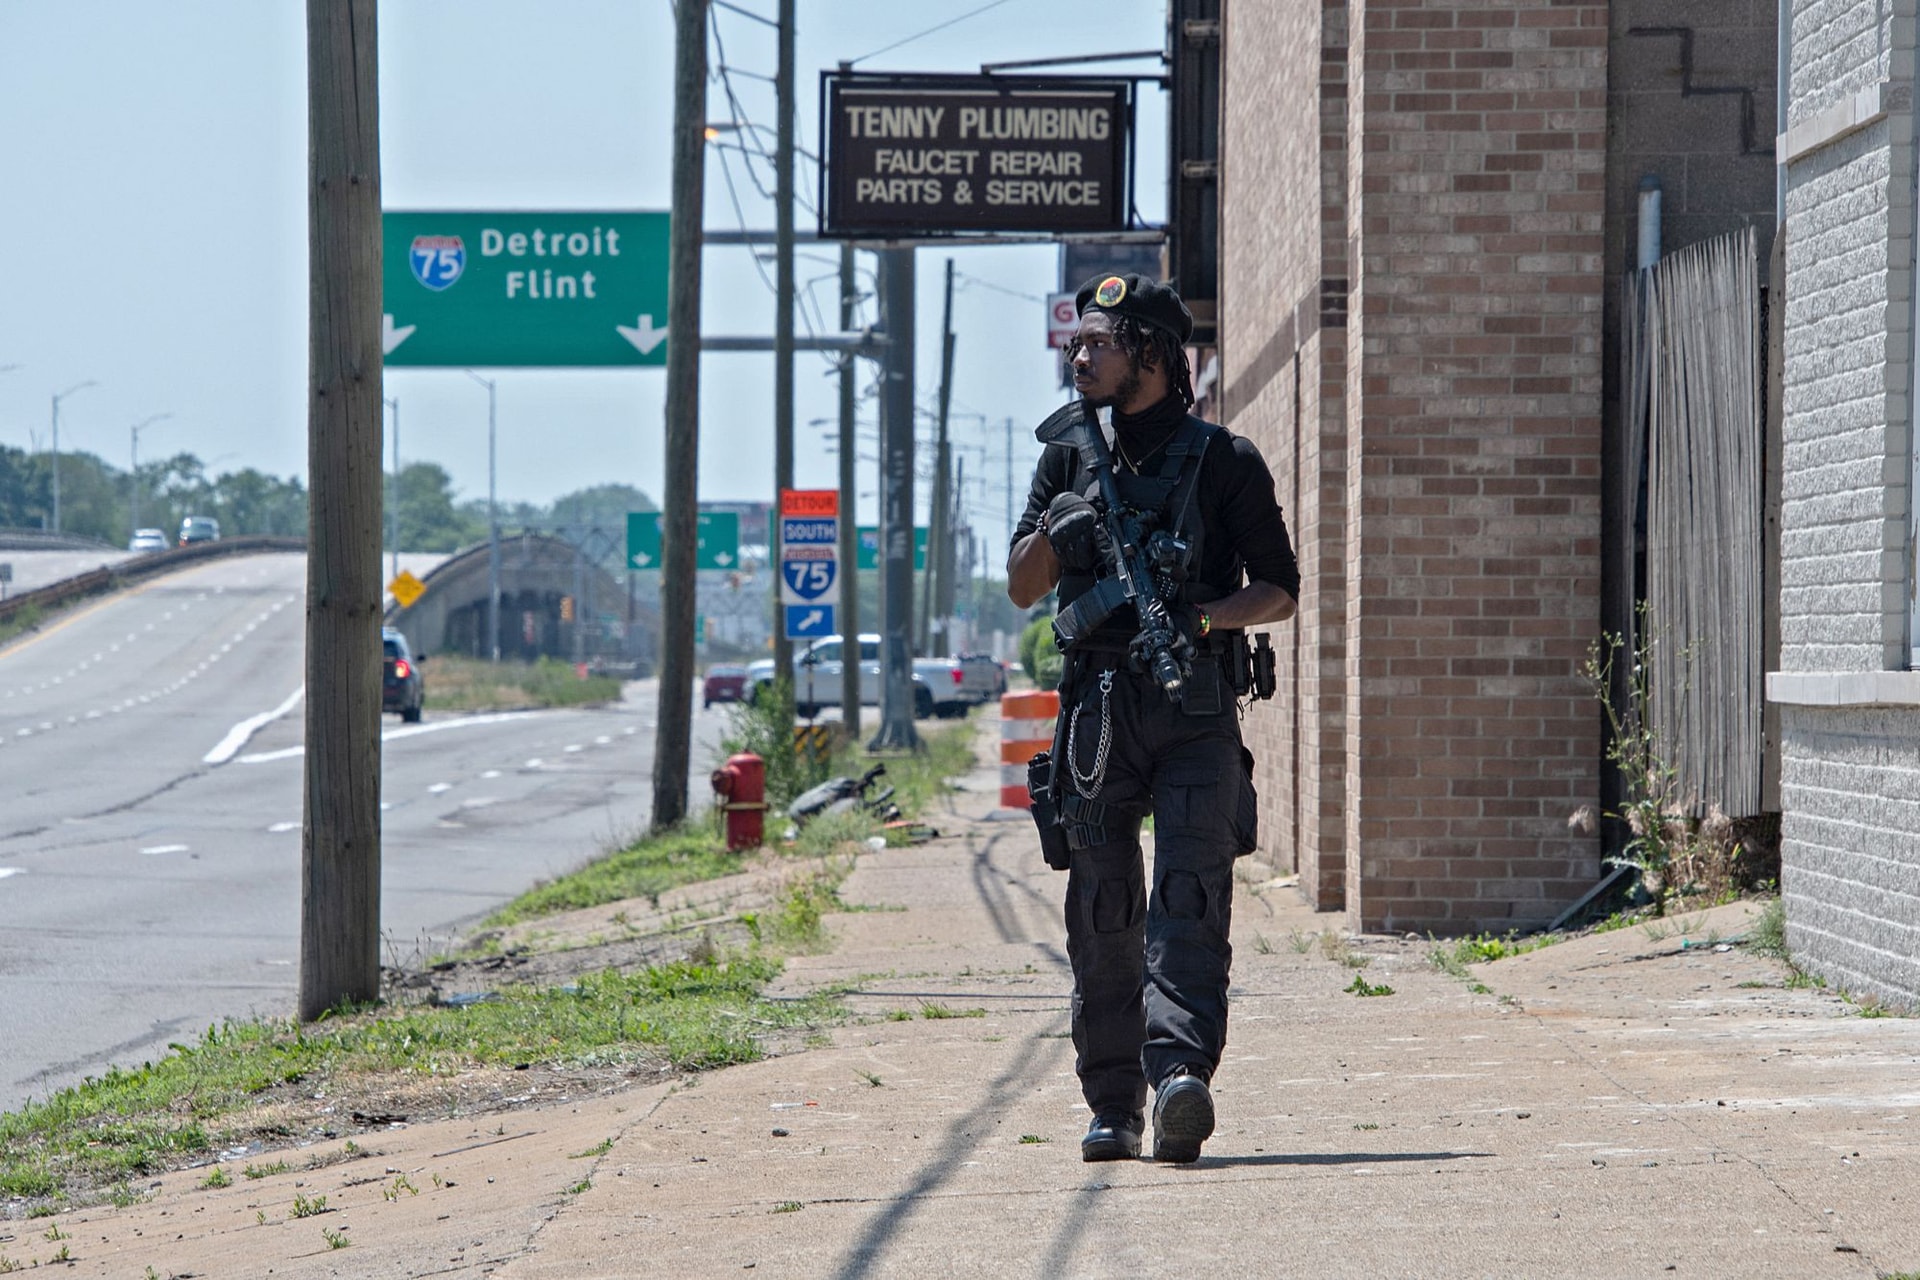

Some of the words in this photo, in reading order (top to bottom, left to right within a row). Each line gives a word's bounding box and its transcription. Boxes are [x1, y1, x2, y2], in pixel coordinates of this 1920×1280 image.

[845, 106, 944, 138] TENNY
[959, 108, 1109, 140] PLUMBING
[875, 150, 979, 175] FAUCET
[990, 152, 1082, 176] REPAIR
[856, 179, 942, 203] PARTS
[954, 181, 973, 205] &
[986, 181, 1100, 205] SERVICE
[481, 227, 620, 256] Detroit
[416, 249, 459, 279] 75
[506, 269, 596, 298] Flint
[785, 496, 834, 510] DETOUR
[786, 523, 836, 540] SOUTH
[789, 562, 830, 590] 75
